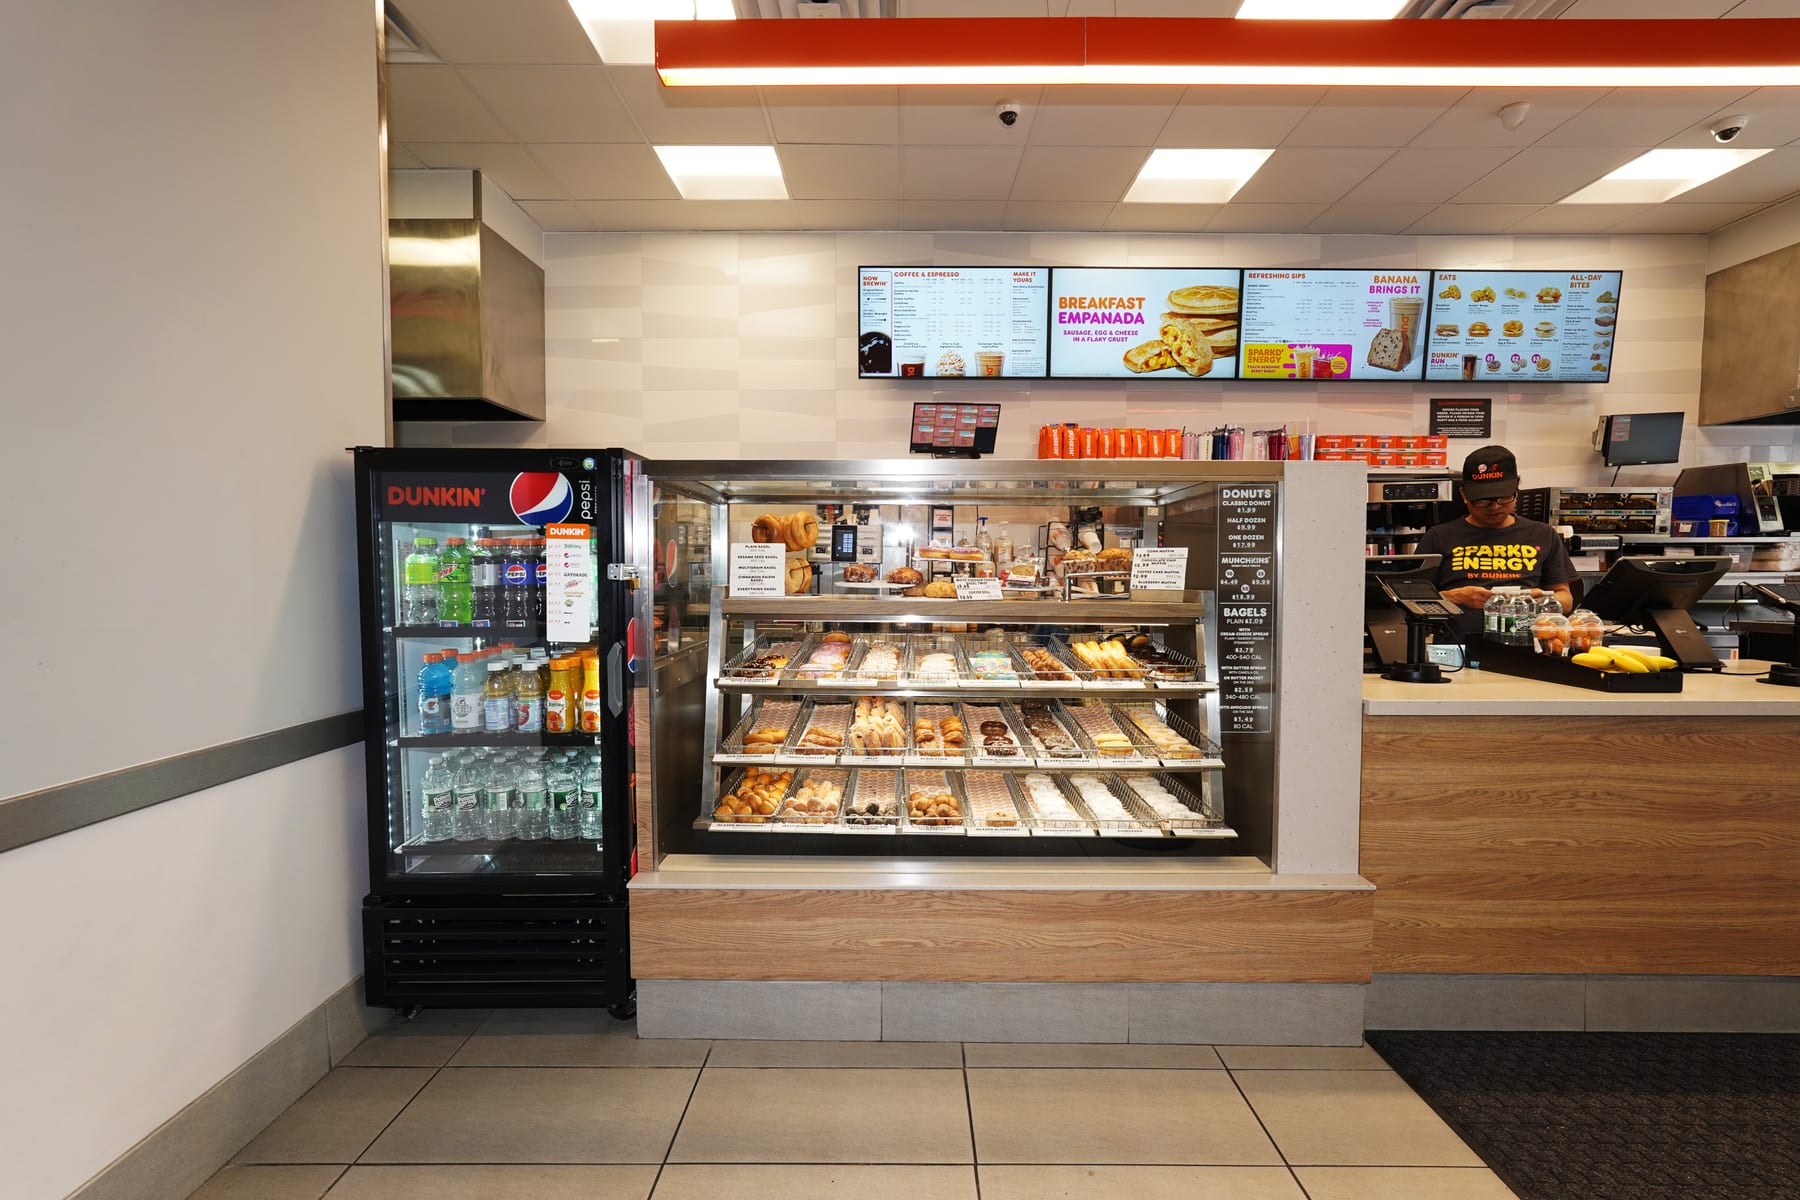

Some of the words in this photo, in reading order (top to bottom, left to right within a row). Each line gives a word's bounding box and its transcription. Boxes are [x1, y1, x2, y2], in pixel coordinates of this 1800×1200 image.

[1374, 275, 1417, 284] BANANA
[1369, 286, 1407, 294] BRINGS
[1411, 286, 1421, 294] IT
[1059, 297, 1145, 310] BREAKFAST
[1058, 312, 1145, 324] EMPANADA
[387, 486, 486, 508] DUNKIN'
[579, 480, 593, 520] pepsi
[1223, 490, 1271, 498] DONUTS
[1452, 557, 1537, 570] ENERGY
[1224, 608, 1267, 617] BAGELS
